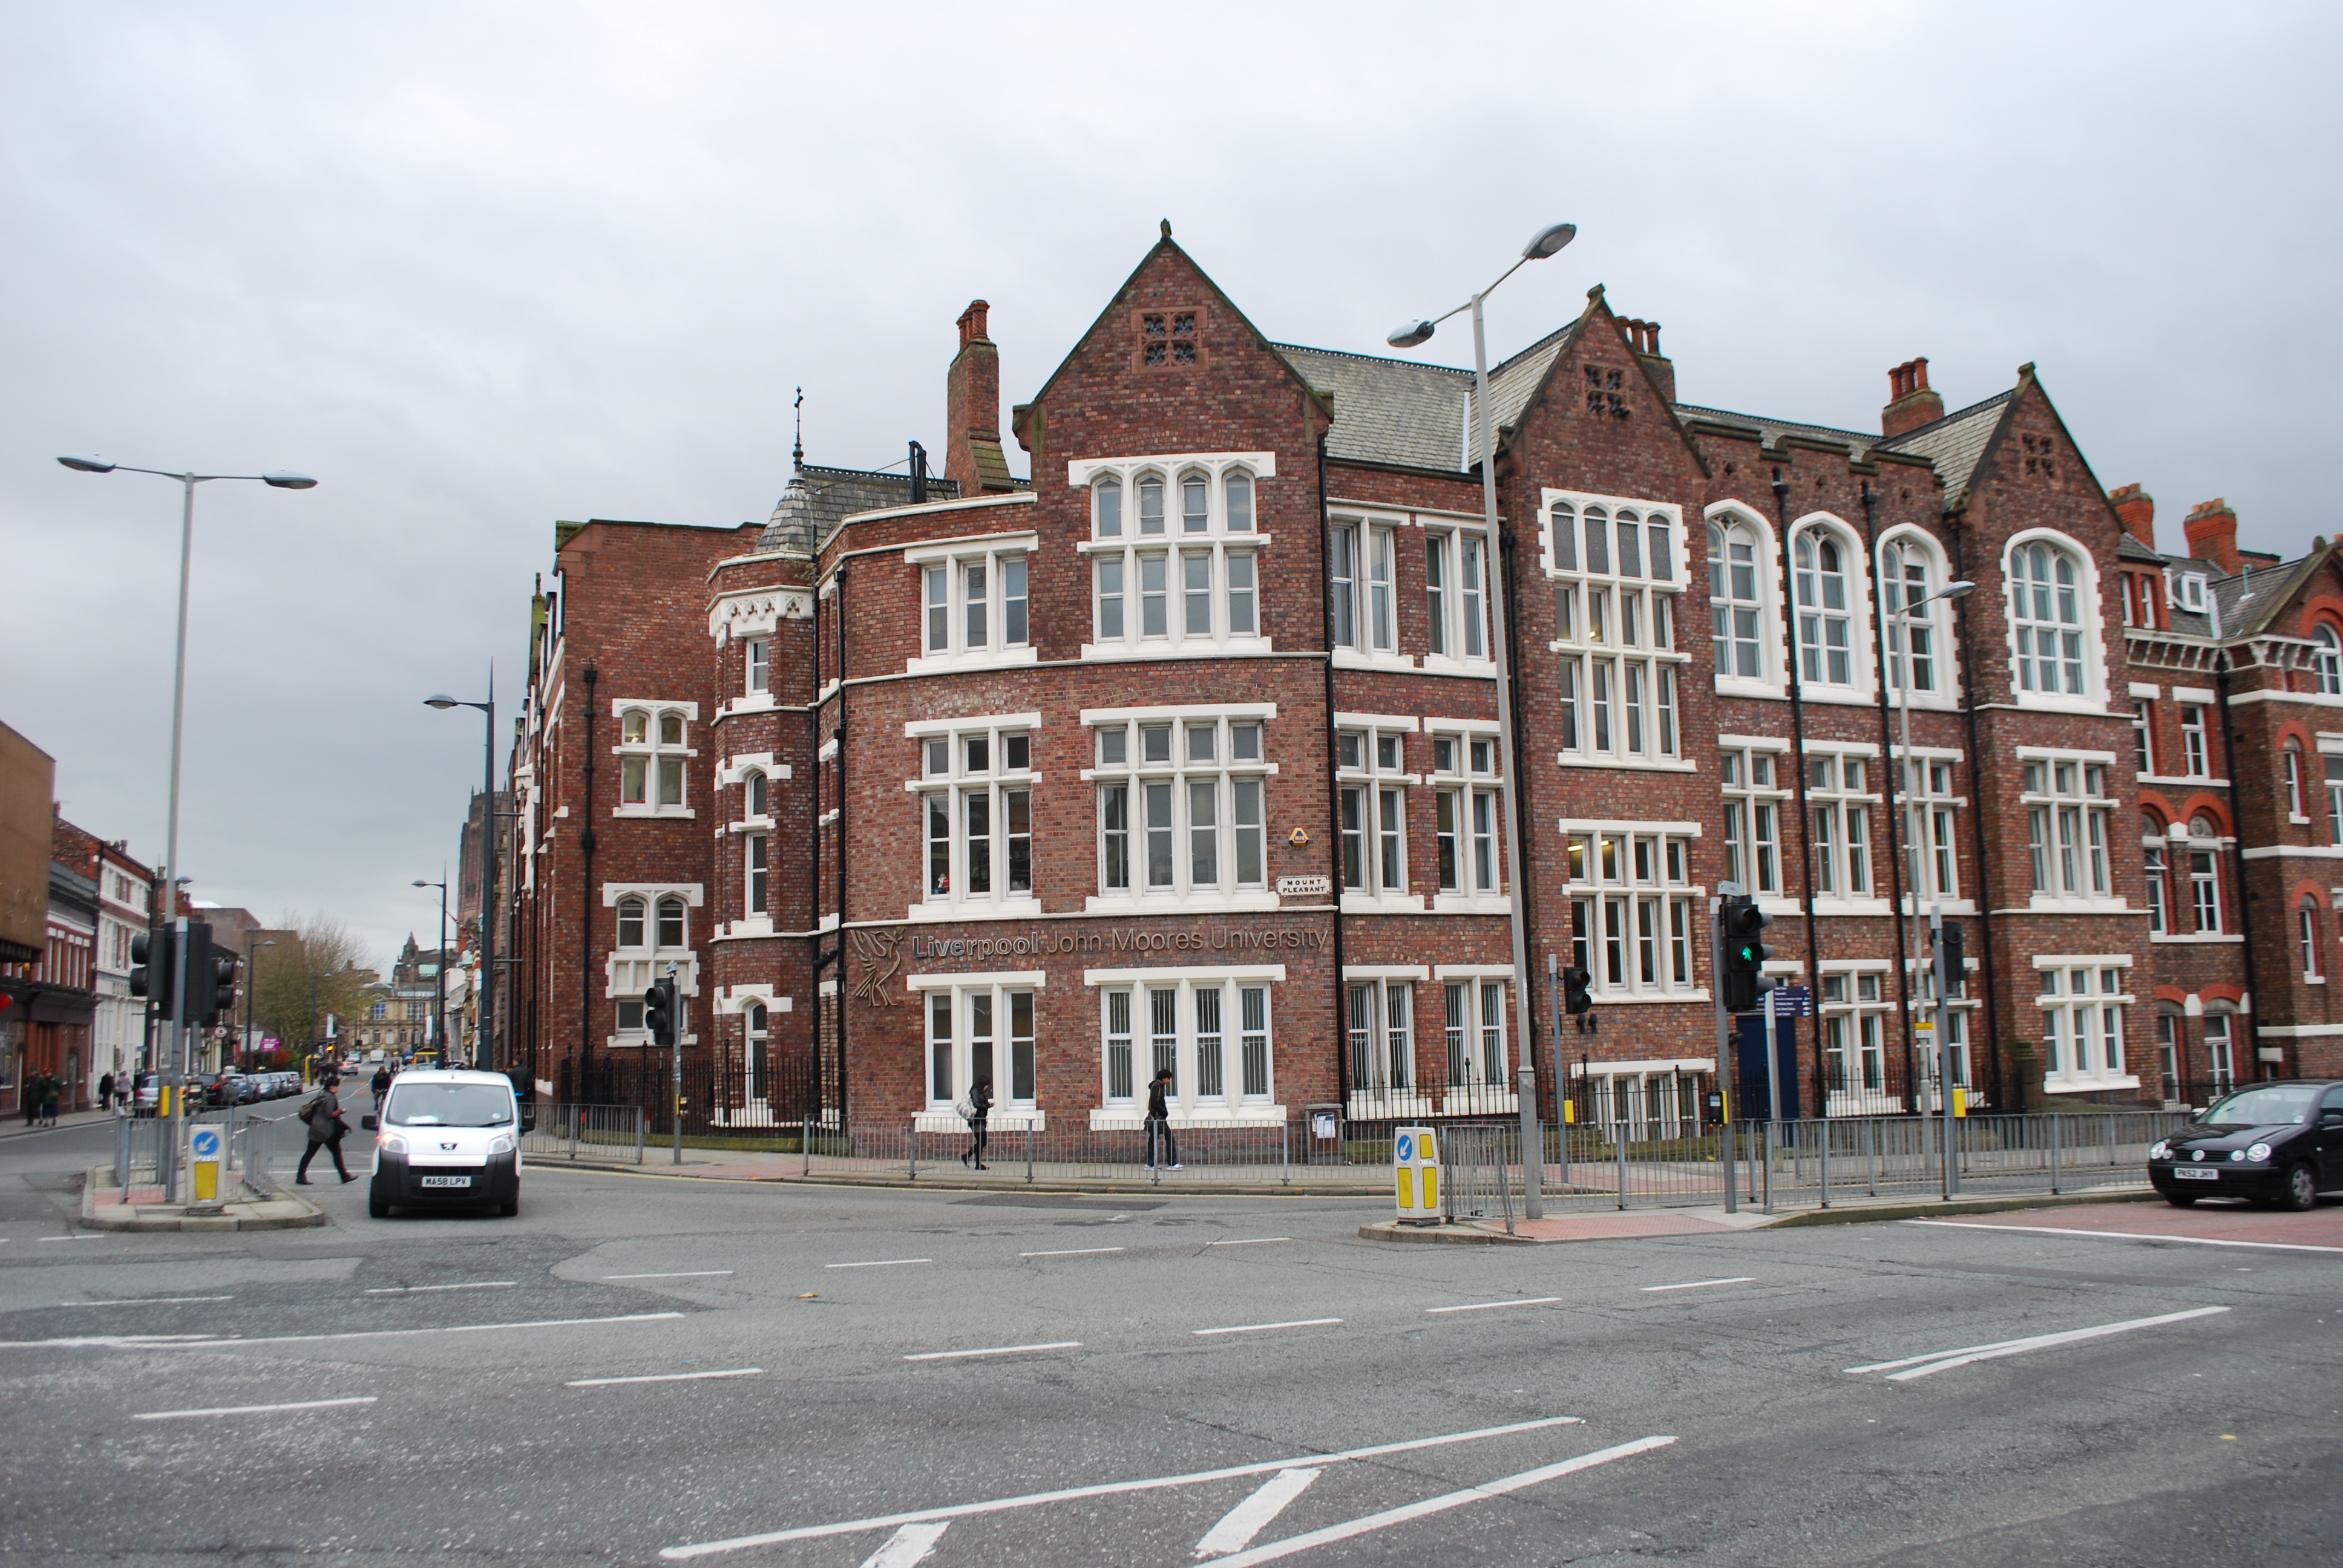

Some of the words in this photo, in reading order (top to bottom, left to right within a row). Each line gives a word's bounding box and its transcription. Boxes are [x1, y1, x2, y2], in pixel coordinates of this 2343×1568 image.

[913, 932, 1038, 961] Liverpool
[1046, 930, 1101, 953] John
[1112, 928, 1204, 951] Moores
[1211, 925, 1328, 952] University
[450, 1177, 467, 1186] LPV
